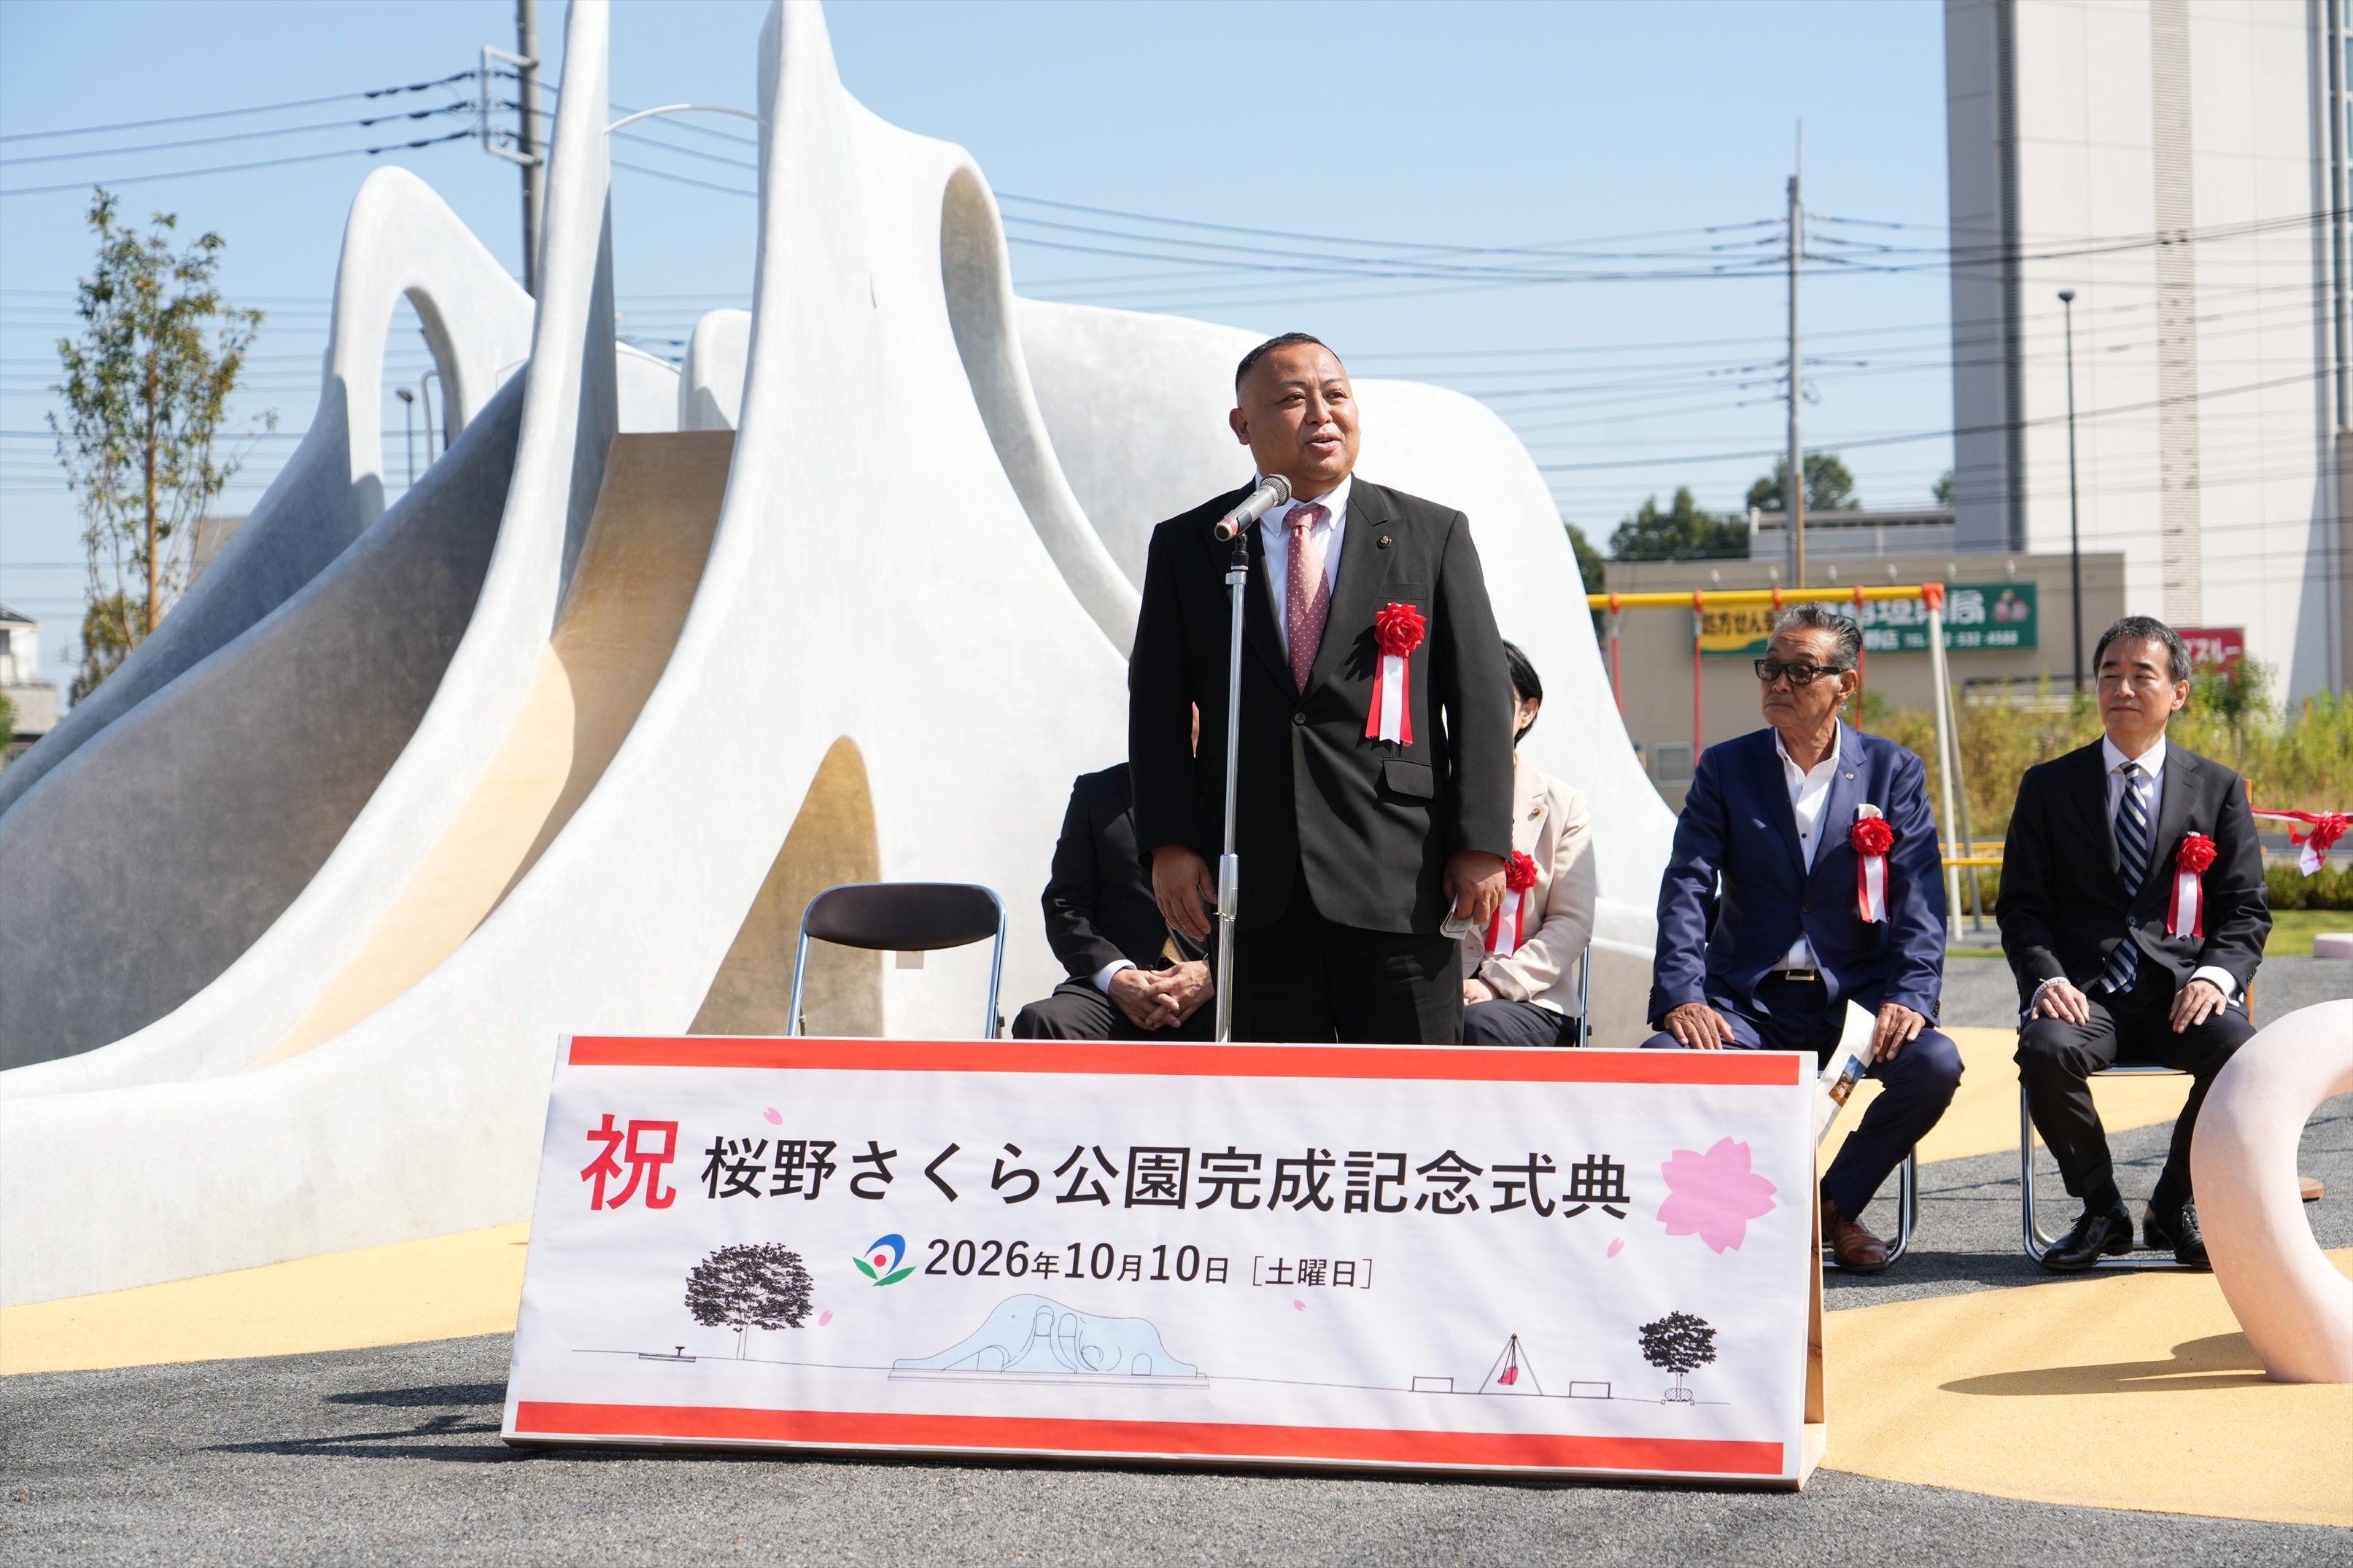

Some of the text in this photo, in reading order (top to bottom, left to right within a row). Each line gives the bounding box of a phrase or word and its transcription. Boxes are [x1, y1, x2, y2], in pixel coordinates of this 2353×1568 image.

[581, 1114, 1629, 1219] 祝 桜野さくら公園完成記念式典
[925, 1239, 1228, 1283] 2026年10月10日
